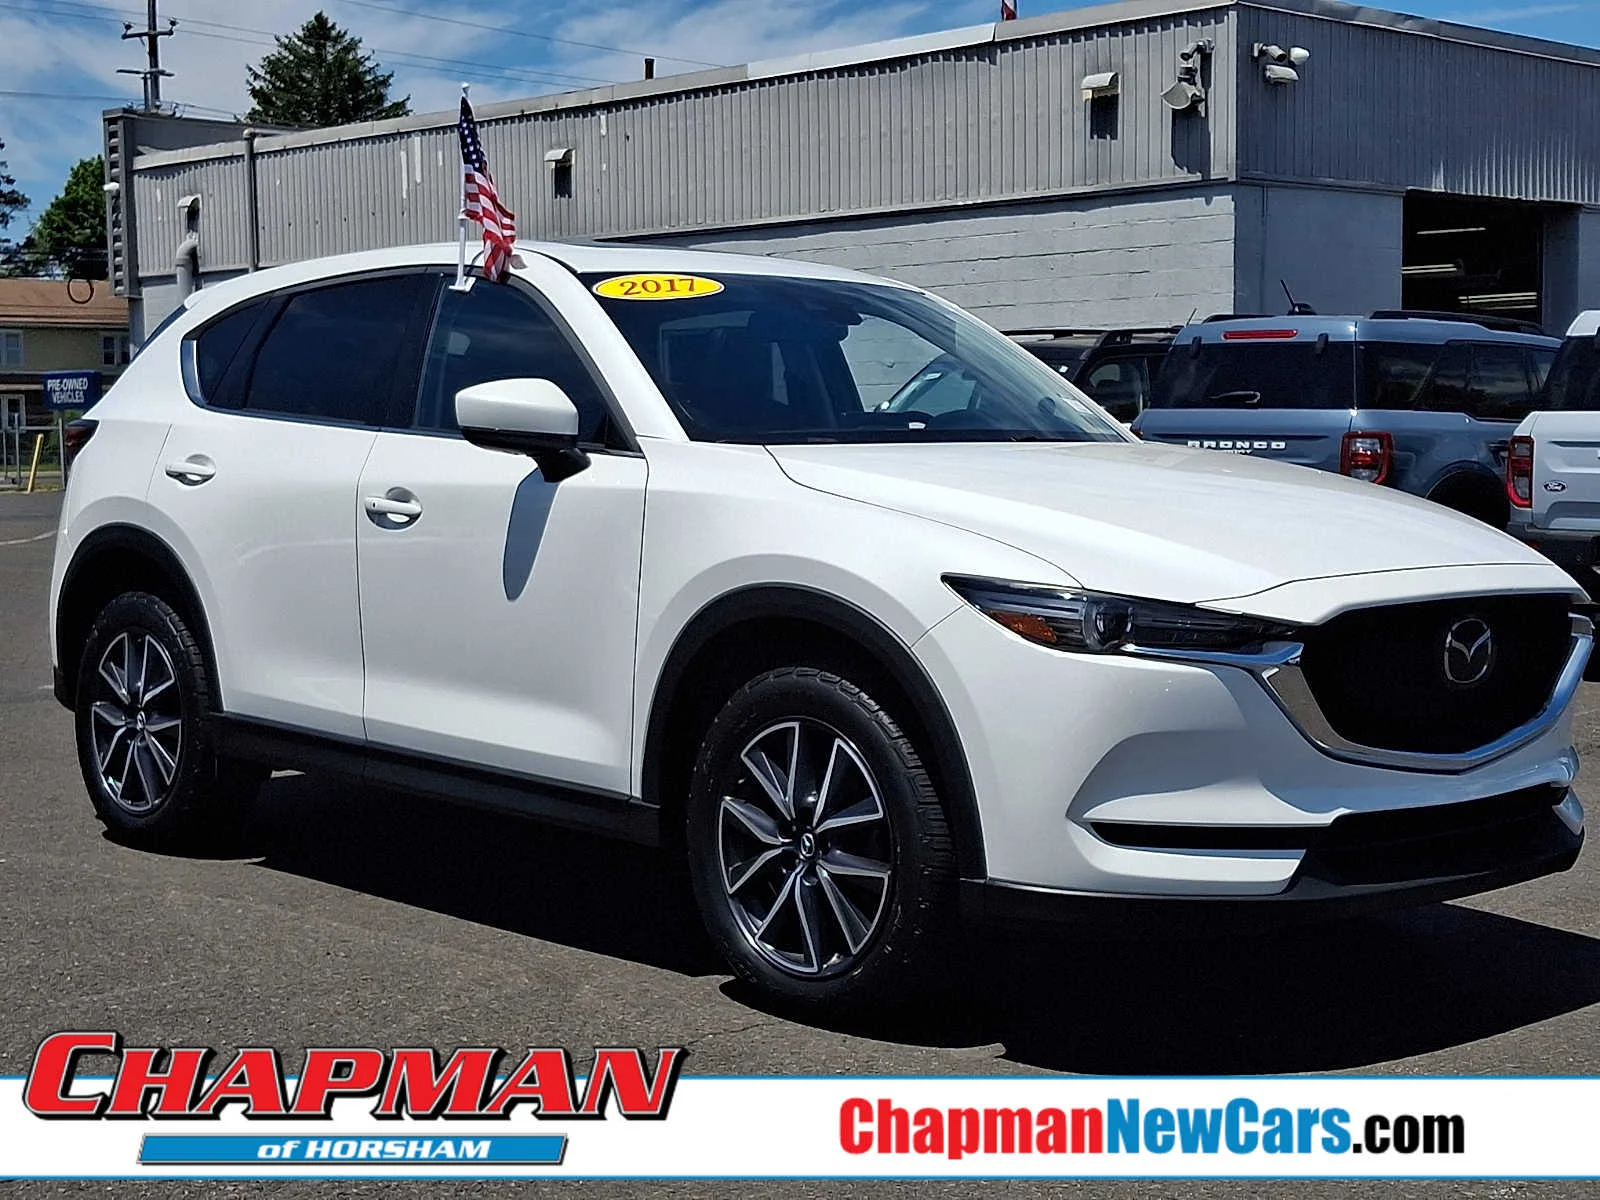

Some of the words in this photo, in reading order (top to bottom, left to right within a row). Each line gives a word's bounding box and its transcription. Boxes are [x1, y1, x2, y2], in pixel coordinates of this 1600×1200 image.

[619, 278, 695, 295] 2017
[47, 377, 88, 391] PRE-OWNED
[52, 390, 85, 403] VEHICLES
